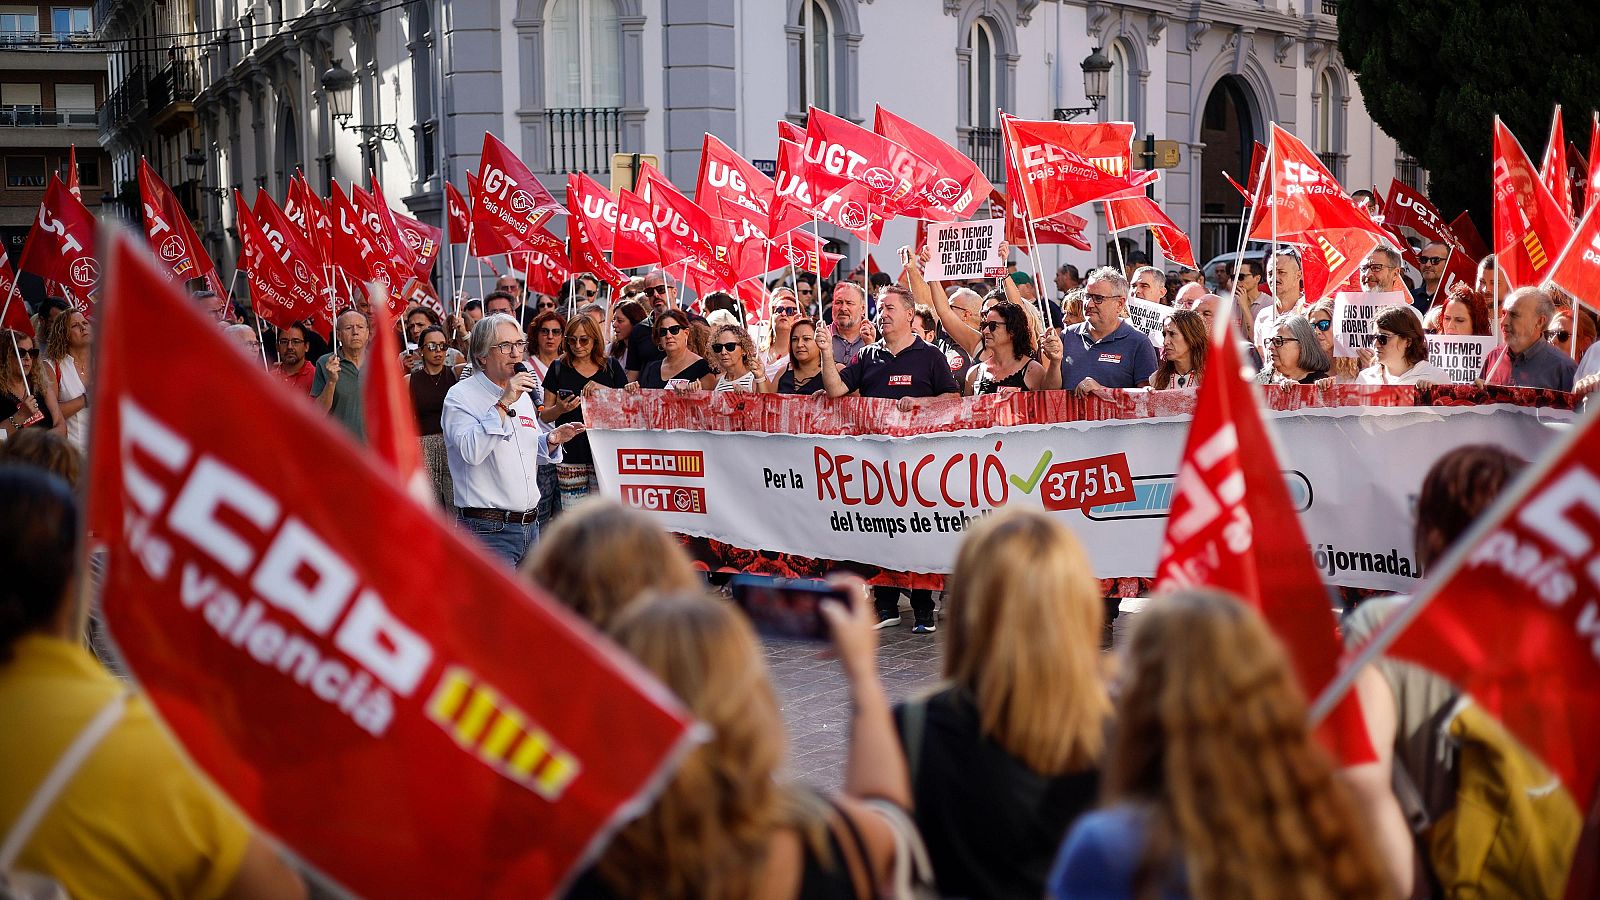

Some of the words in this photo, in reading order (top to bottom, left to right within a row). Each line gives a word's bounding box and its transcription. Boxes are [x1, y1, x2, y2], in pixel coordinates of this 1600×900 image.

[804, 137, 868, 179] UGT
[708, 160, 747, 192] UG
[583, 194, 618, 223] UG
[1396, 192, 1440, 224] UGT
[938, 226, 959, 241] MÁS
[961, 225, 993, 239] TIEMPO
[938, 240, 960, 252] PARA
[963, 239, 974, 251] LO
[976, 237, 993, 249] QUE
[941, 252, 953, 264] DE
[955, 250, 988, 263] VERDAD
[944, 262, 983, 276] IMPORTA
[1129, 305, 1161, 322] RABAJAR
[1342, 320, 1368, 333] ROBAR
[1349, 334, 1360, 347] AL
[1428, 339, 1441, 354] ÁS
[1443, 342, 1482, 355] TIEMPO
[1430, 355, 1443, 368] RA
[1446, 356, 1459, 368] LO
[1462, 356, 1482, 369] QUE
[1444, 369, 1476, 382] RDAD
[622, 453, 676, 471] CCOO
[763, 467, 787, 489] Per
[790, 468, 804, 490] la
[813, 440, 1009, 509] REDUCCIÓ
[627, 488, 671, 510] UGT
[830, 510, 854, 532] del
[856, 511, 907, 538] temps
[910, 511, 932, 533] de
